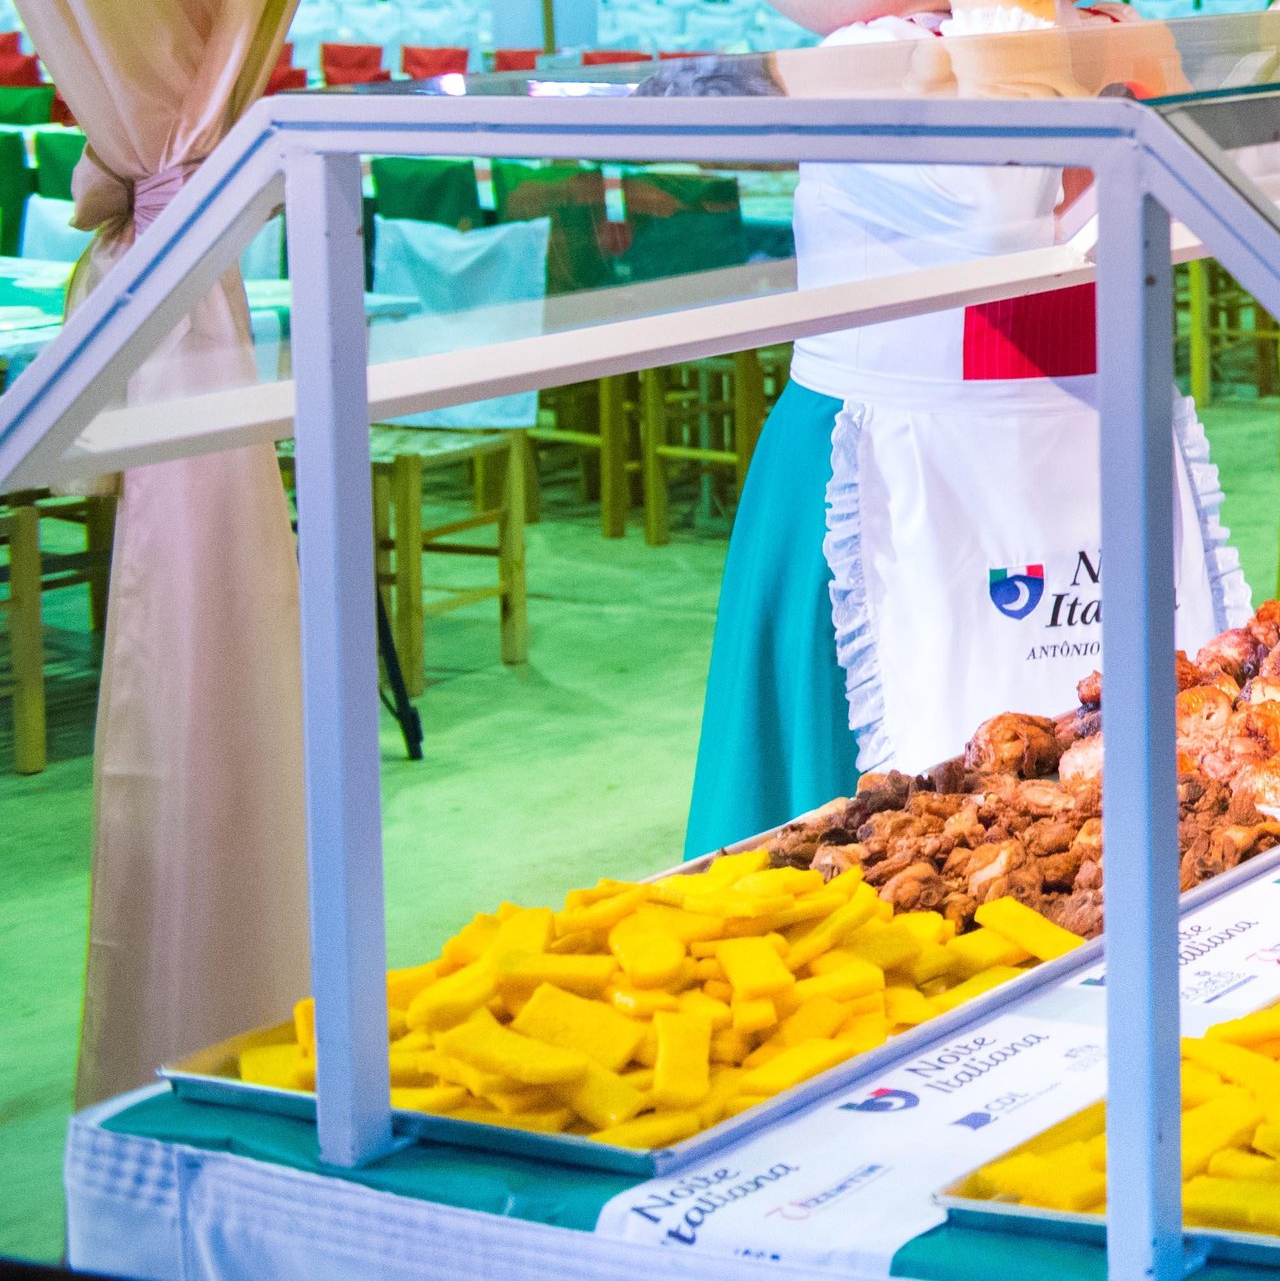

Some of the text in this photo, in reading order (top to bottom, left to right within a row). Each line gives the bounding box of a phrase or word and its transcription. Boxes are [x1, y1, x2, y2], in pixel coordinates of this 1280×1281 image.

[1026, 641, 1100, 661] ANTÔNIO
[1179, 920, 1259, 966] aliana
[903, 1036, 997, 1079] Noite
[924, 1032, 1049, 1094] Italiana
[630, 1167, 740, 1224] Noite
[666, 1162, 799, 1246] taliana
